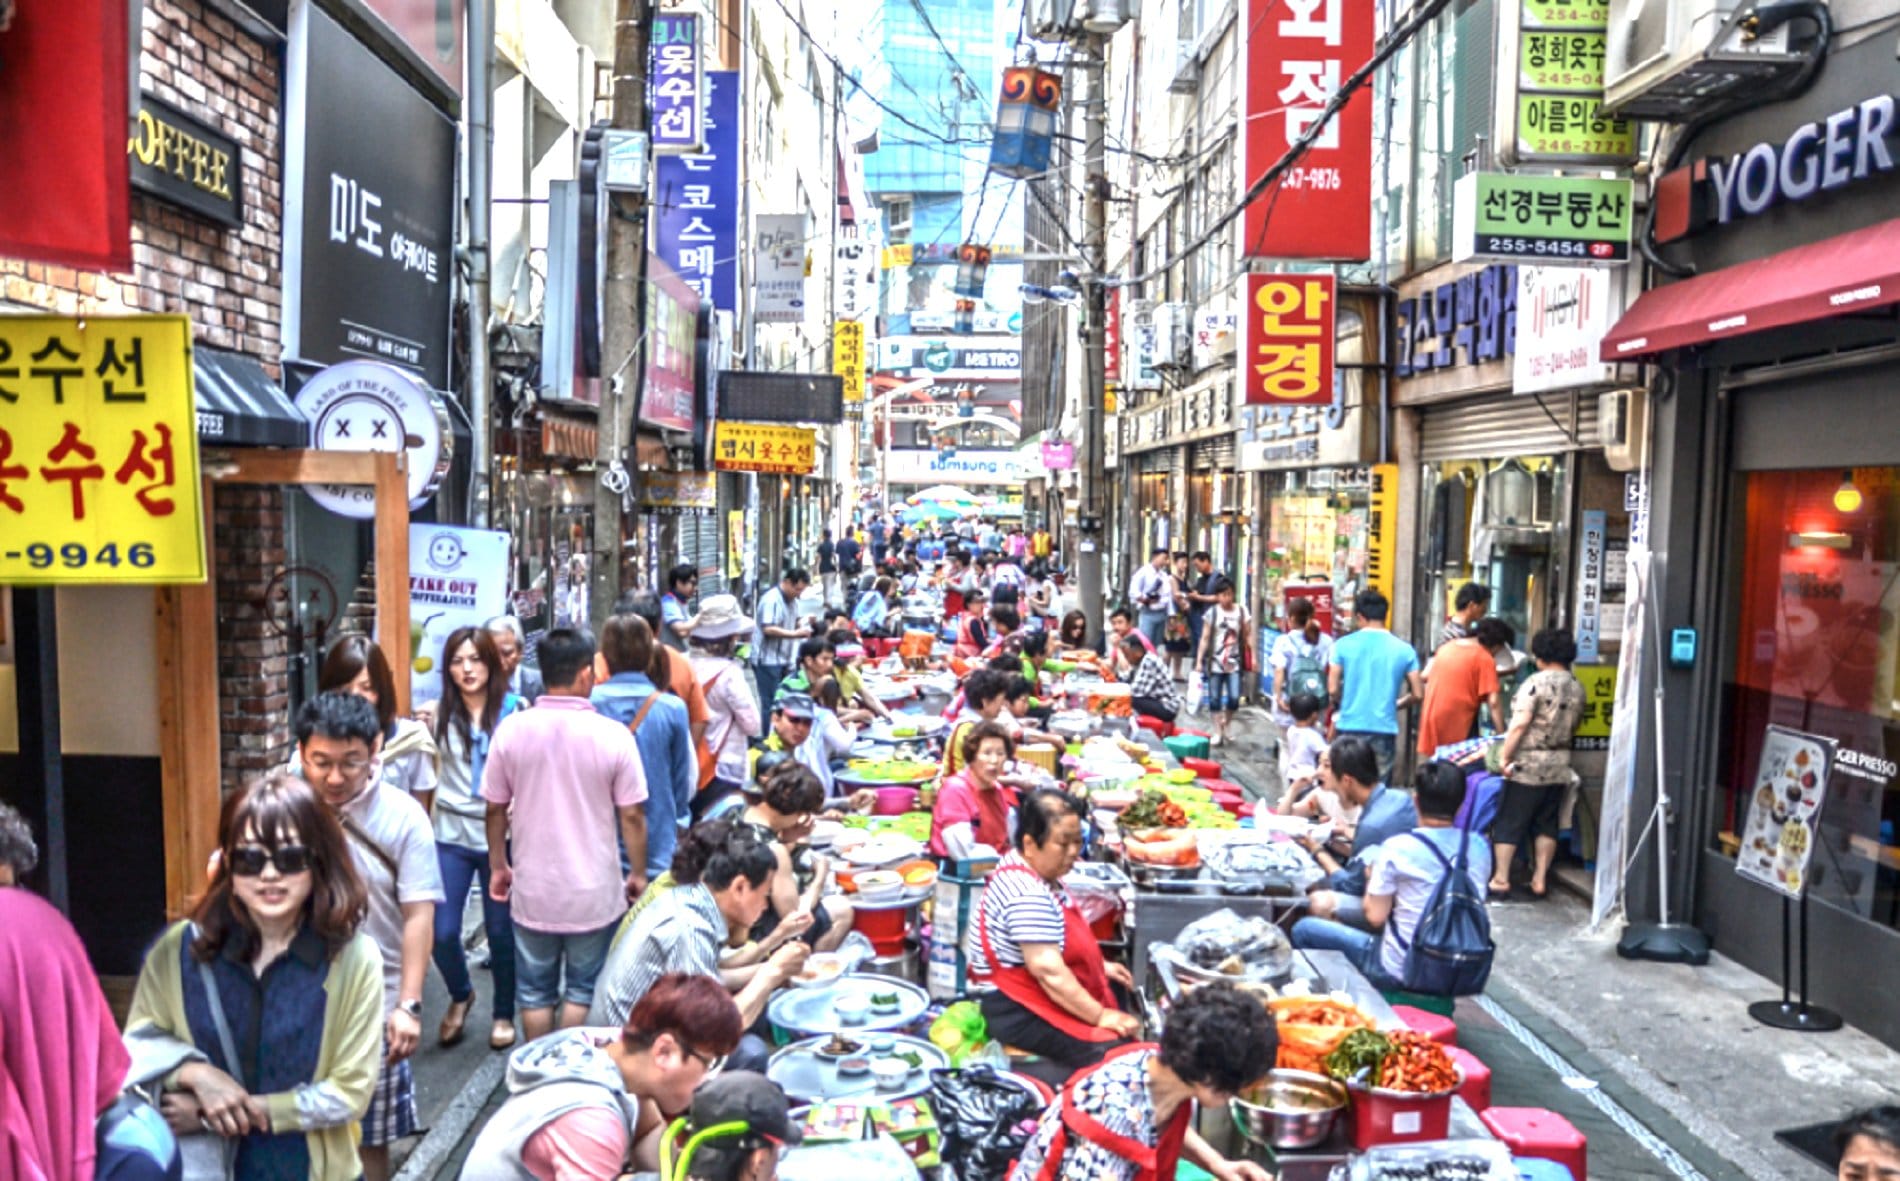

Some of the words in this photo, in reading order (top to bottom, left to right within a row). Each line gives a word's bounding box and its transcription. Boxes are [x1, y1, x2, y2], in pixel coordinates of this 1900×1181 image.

[658, 45, 695, 138] 옷수선
[1710, 94, 1896, 224] YOGER
[330, 171, 384, 259] 미도
[1484, 188, 1626, 230] 선경부동산
[1490, 237, 1586, 256] 255-5454
[1254, 281, 1330, 399] 안경
[929, 459, 998, 473] samsung
[448, 580, 478, 596] OUT
